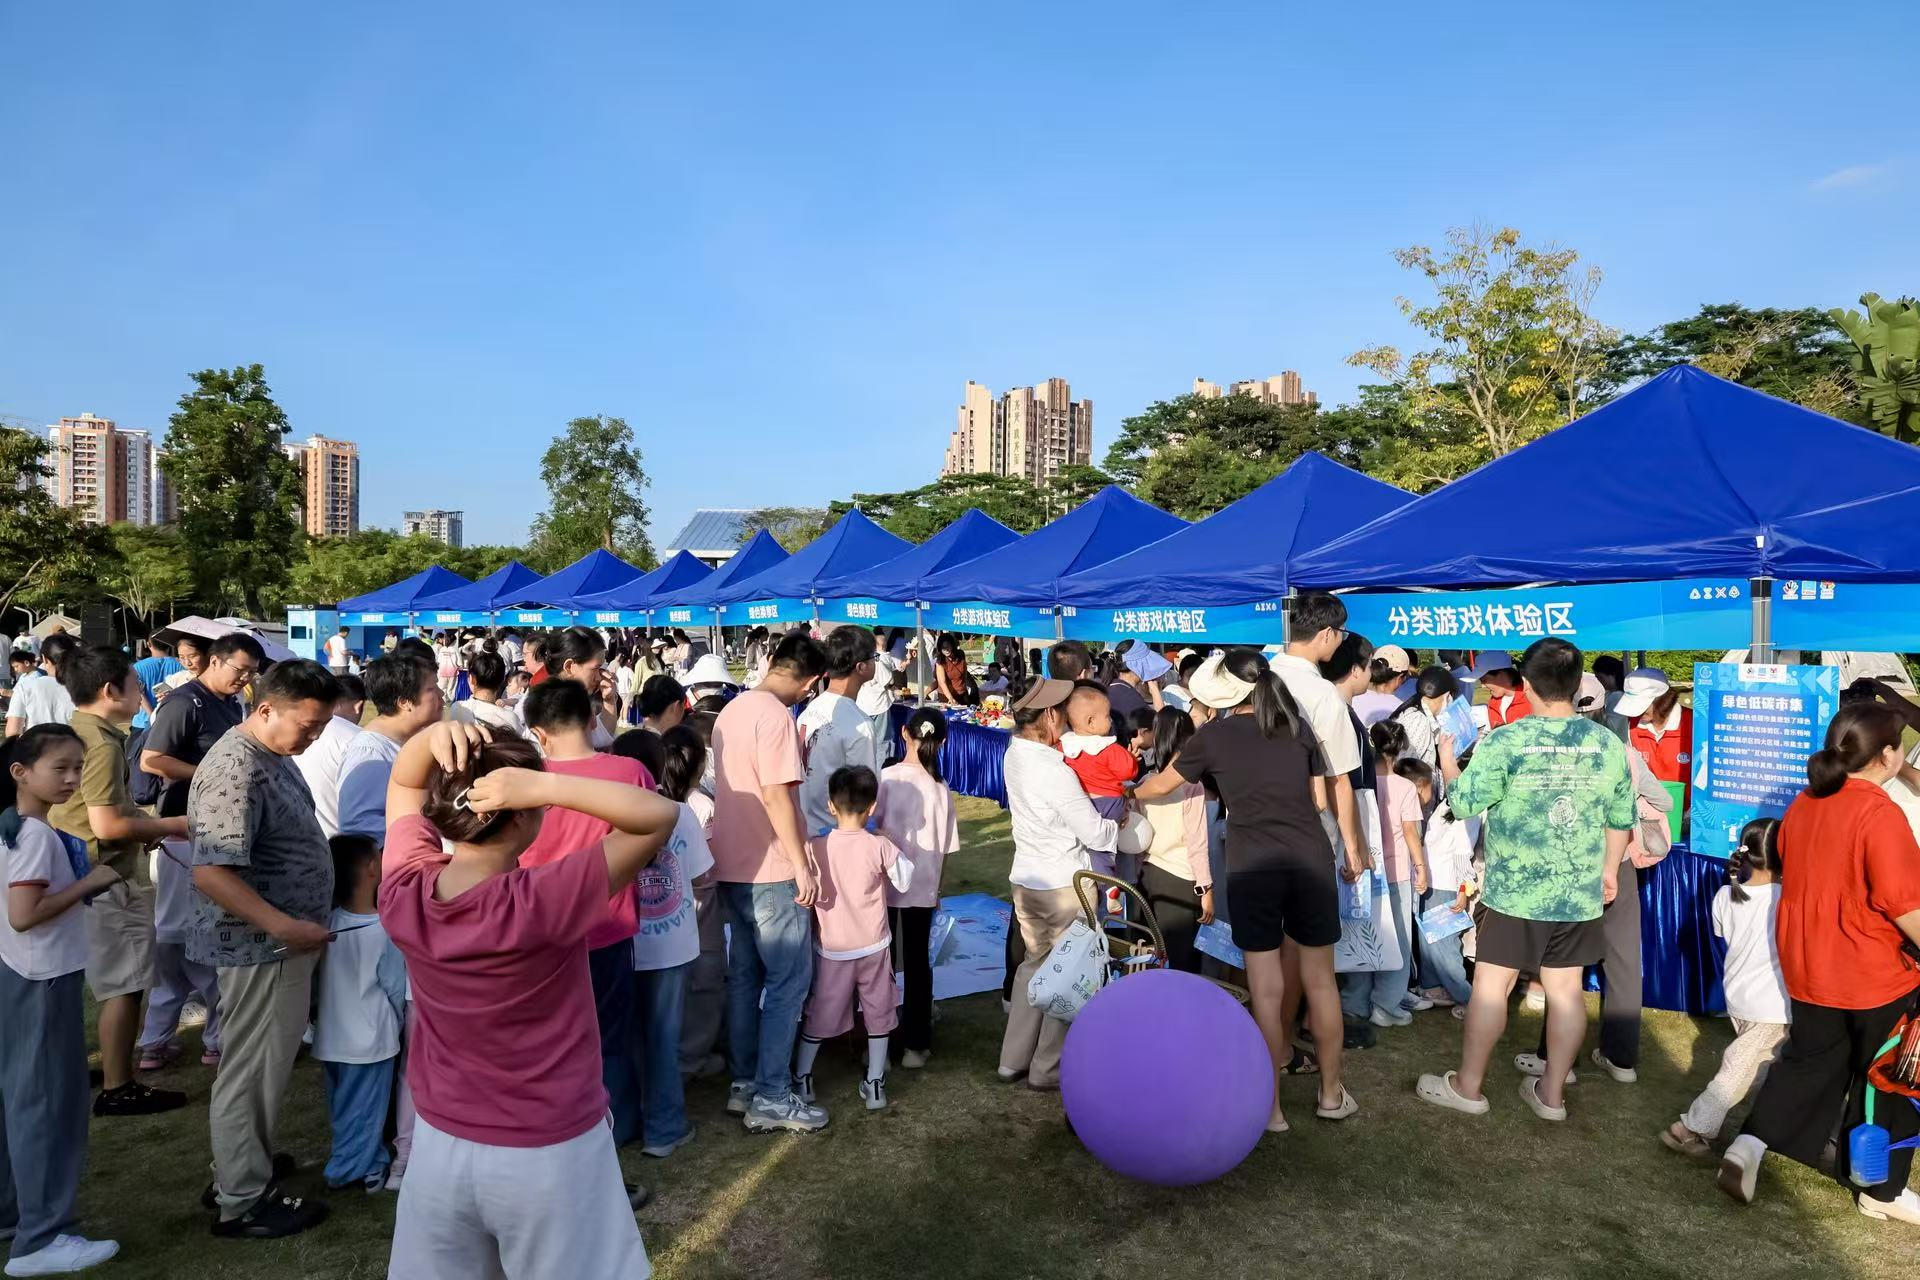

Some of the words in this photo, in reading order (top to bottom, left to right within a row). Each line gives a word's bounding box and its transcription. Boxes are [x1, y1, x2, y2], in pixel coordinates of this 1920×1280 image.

[748, 604, 779, 619] 绿色换享区
[952, 607, 1012, 629] 分类游戏体验区
[1112, 609, 1207, 634] 分类游戏体验区
[1388, 602, 1577, 637] 分类游戏体验区
[1722, 695, 1803, 712] 绿色低碳市集
